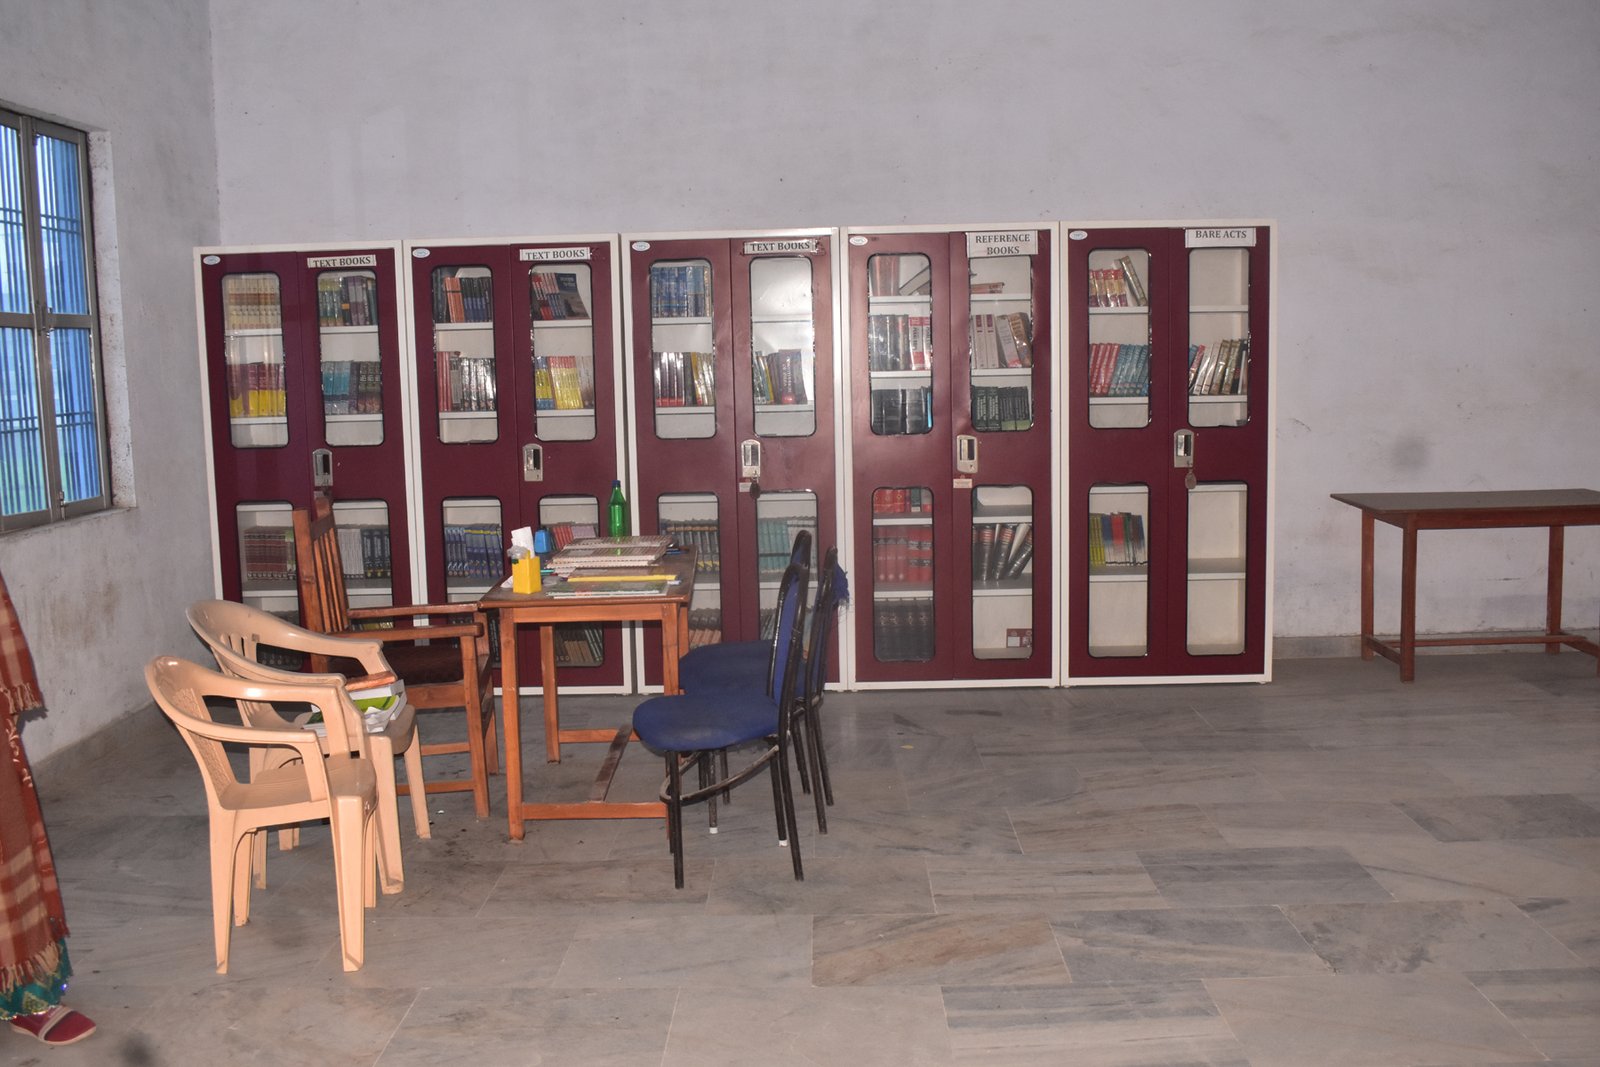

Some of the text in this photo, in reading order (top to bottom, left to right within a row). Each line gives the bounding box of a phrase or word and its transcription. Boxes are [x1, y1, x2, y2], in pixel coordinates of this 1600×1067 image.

[975, 233, 1031, 244] REFERENCE
[1195, 229, 1247, 239] BARE ACTS
[750, 241, 810, 252] TEXT BOOKS
[986, 245, 1020, 255] BOOKS
[525, 249, 585, 260] TEXT BOOKS
[313, 256, 371, 268] TEXT BOOKS
